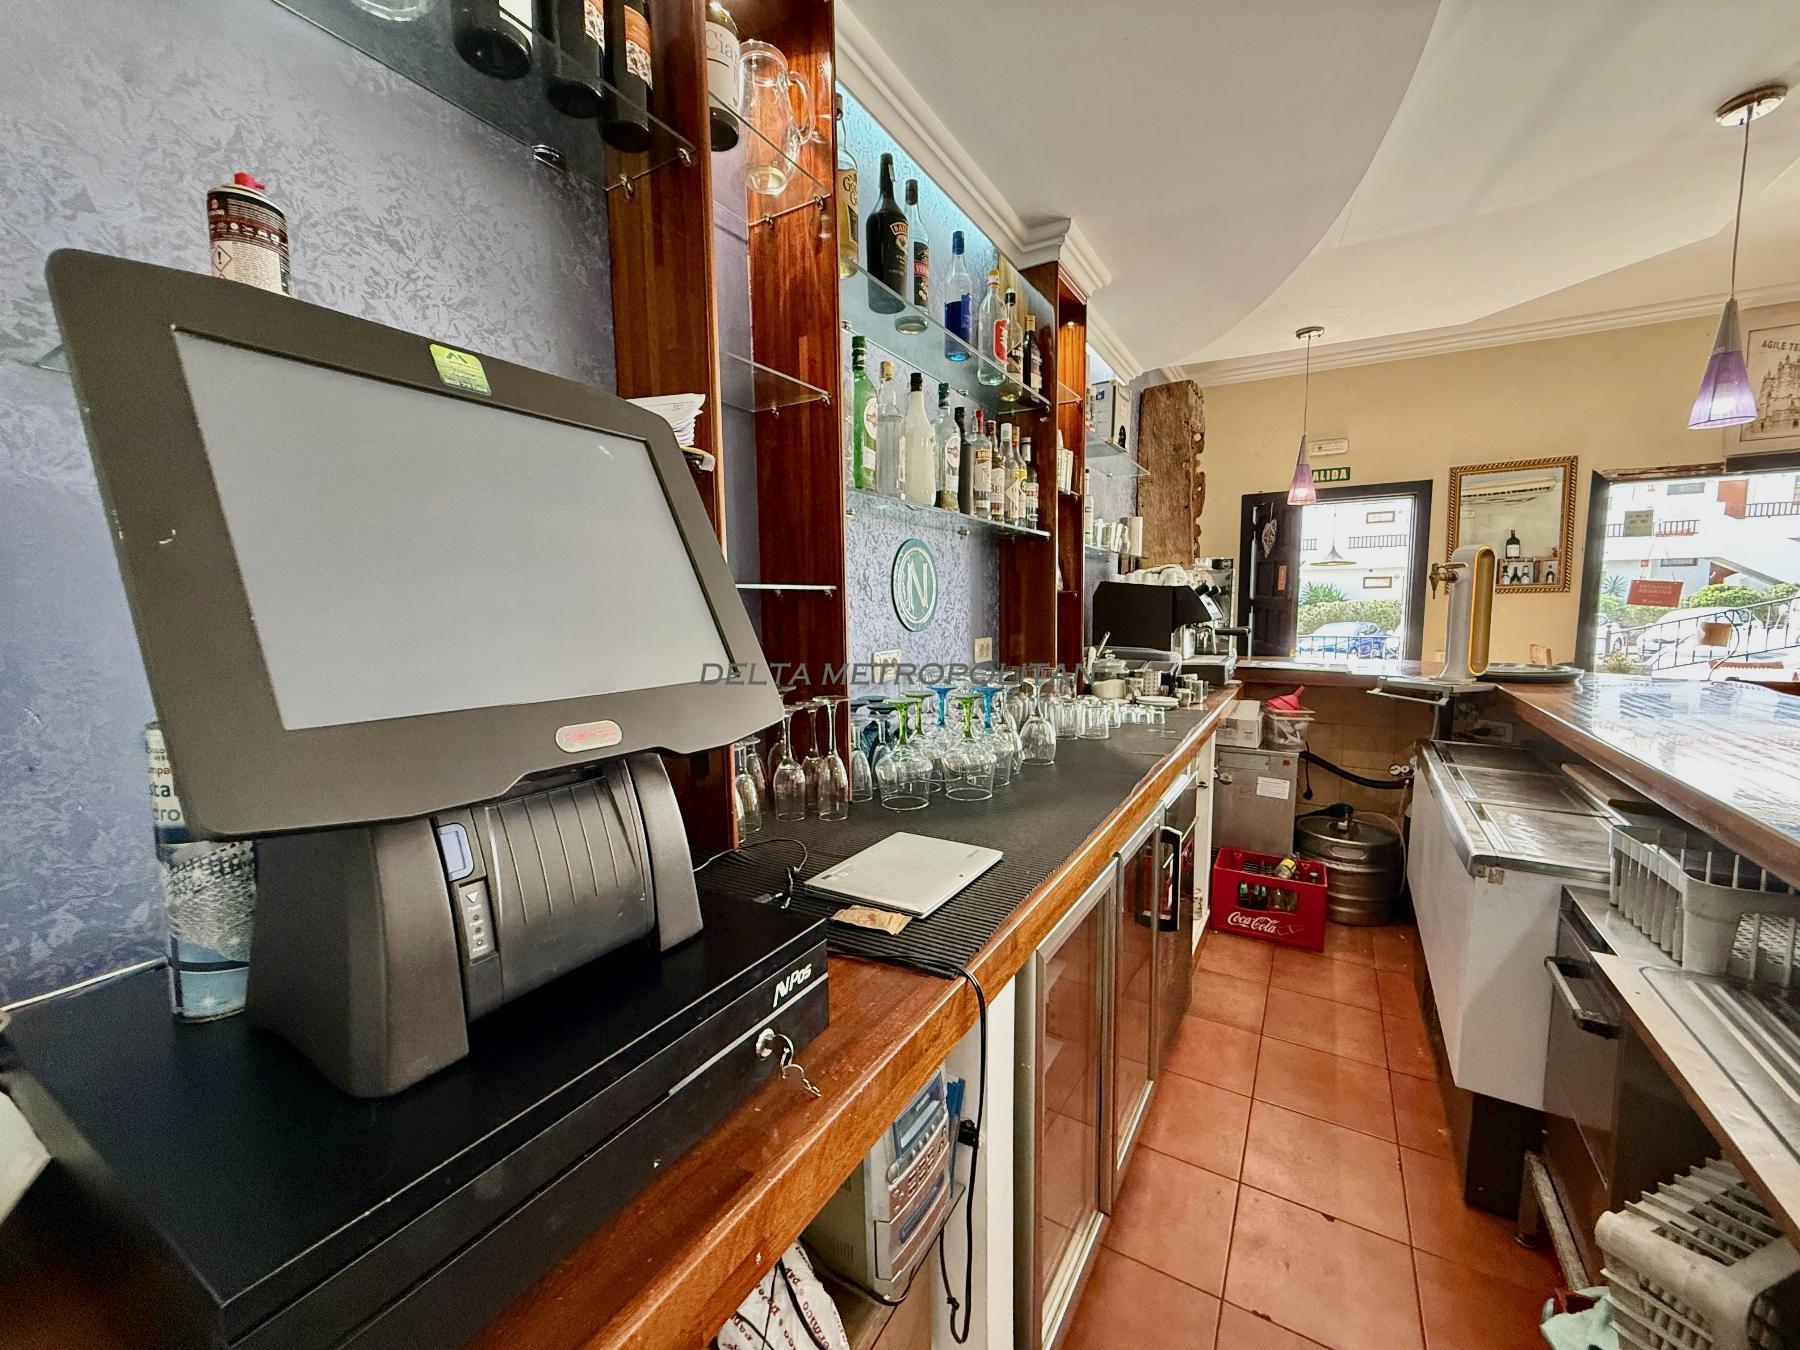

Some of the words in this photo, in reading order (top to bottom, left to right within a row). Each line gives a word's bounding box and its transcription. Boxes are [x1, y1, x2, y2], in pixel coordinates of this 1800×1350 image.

[1761, 340, 1787, 351] AGILE
[1789, 342, 1800, 352] TE
[1312, 468, 1348, 482] ALIDA
